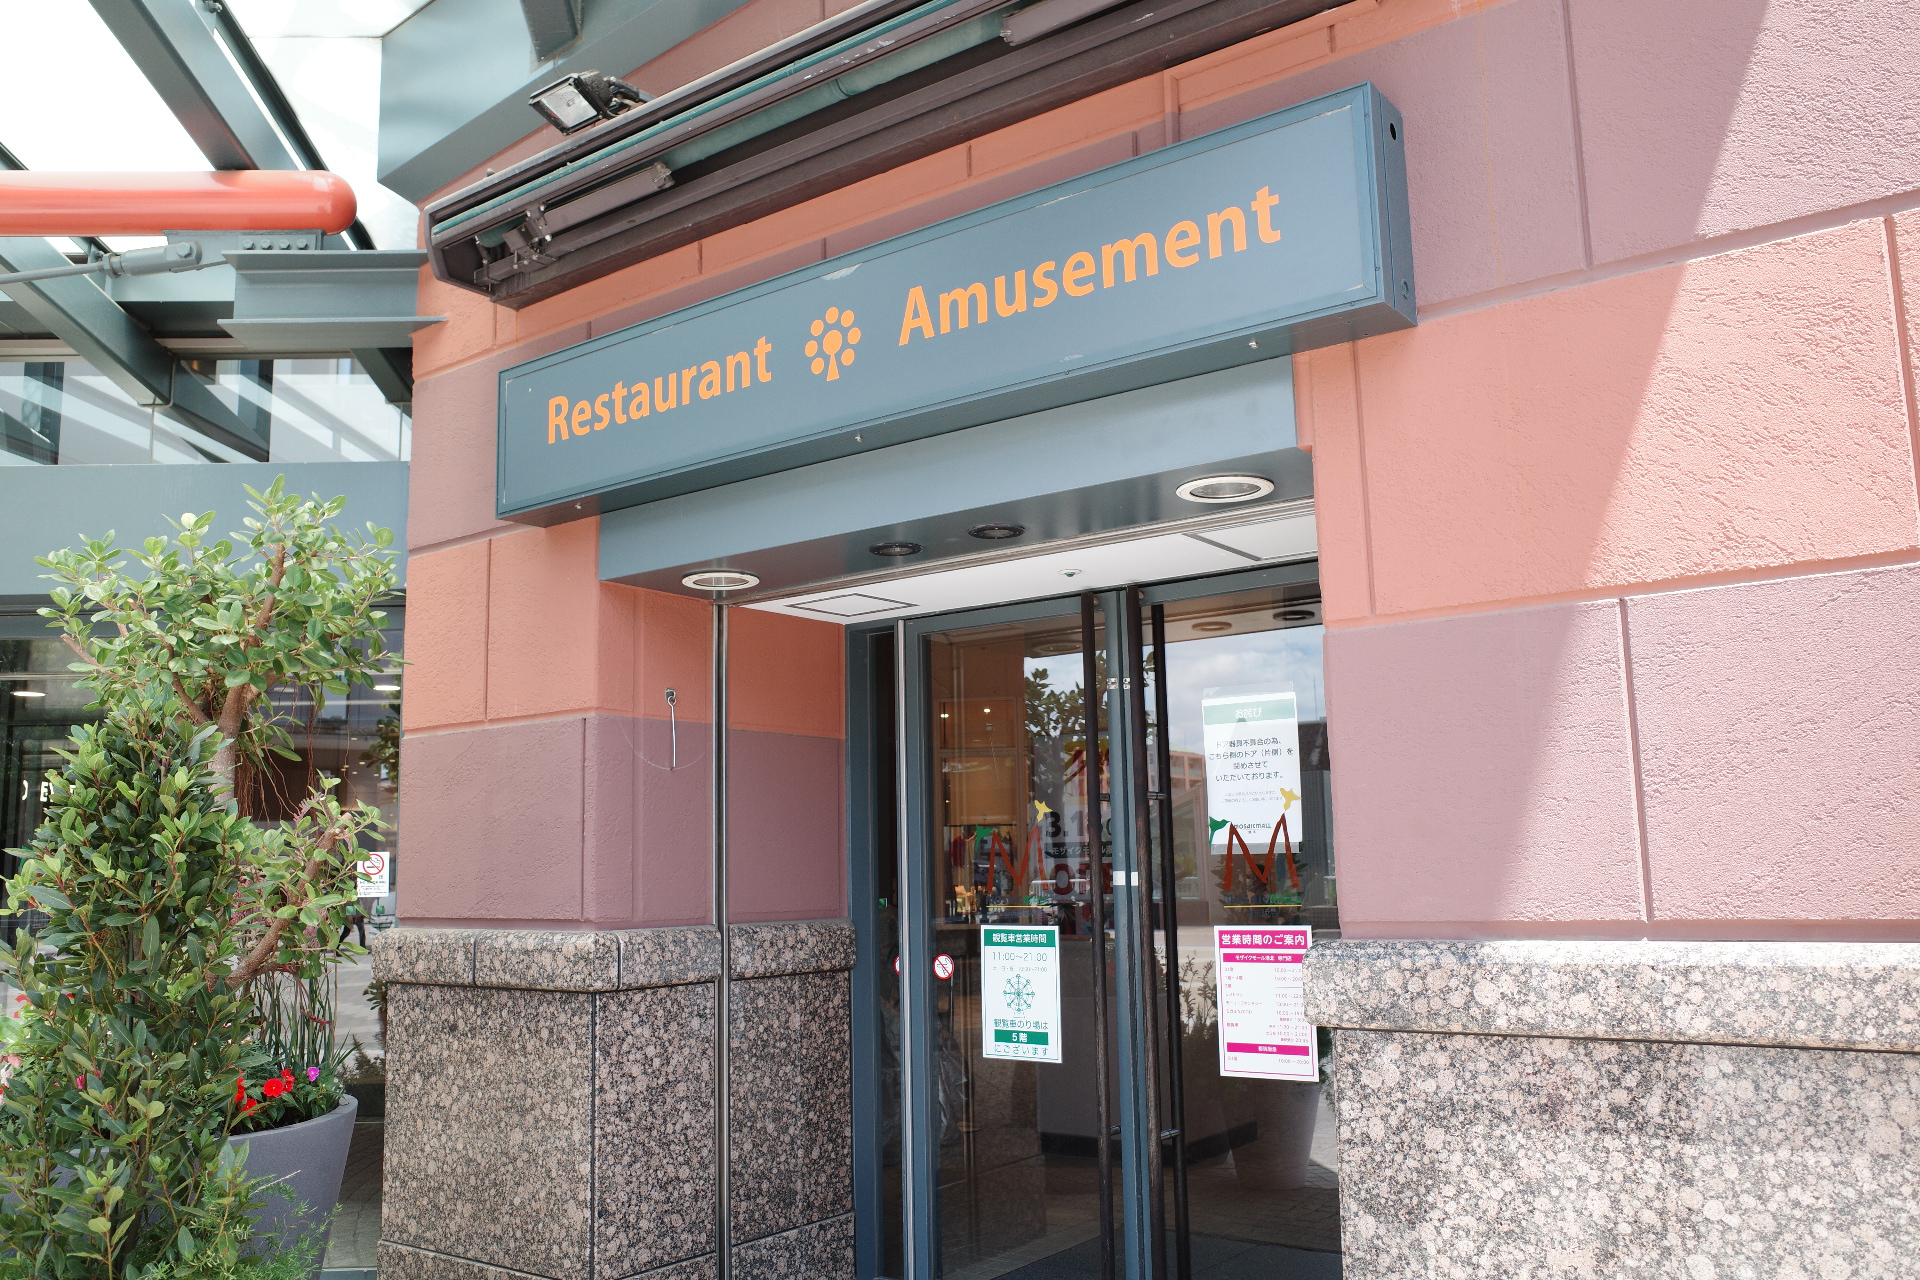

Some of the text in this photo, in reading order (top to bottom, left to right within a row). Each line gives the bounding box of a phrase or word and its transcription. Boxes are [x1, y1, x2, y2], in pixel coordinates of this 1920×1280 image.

[548, 185, 1281, 445] Restaurant Amusement
[1234, 707, 1263, 719] お詫び
[992, 933, 1047, 944] 観覧車営業時間
[1221, 933, 1305, 946] 営業時間のご案内
[993, 1018, 1049, 1030] 観覧車のり場は
